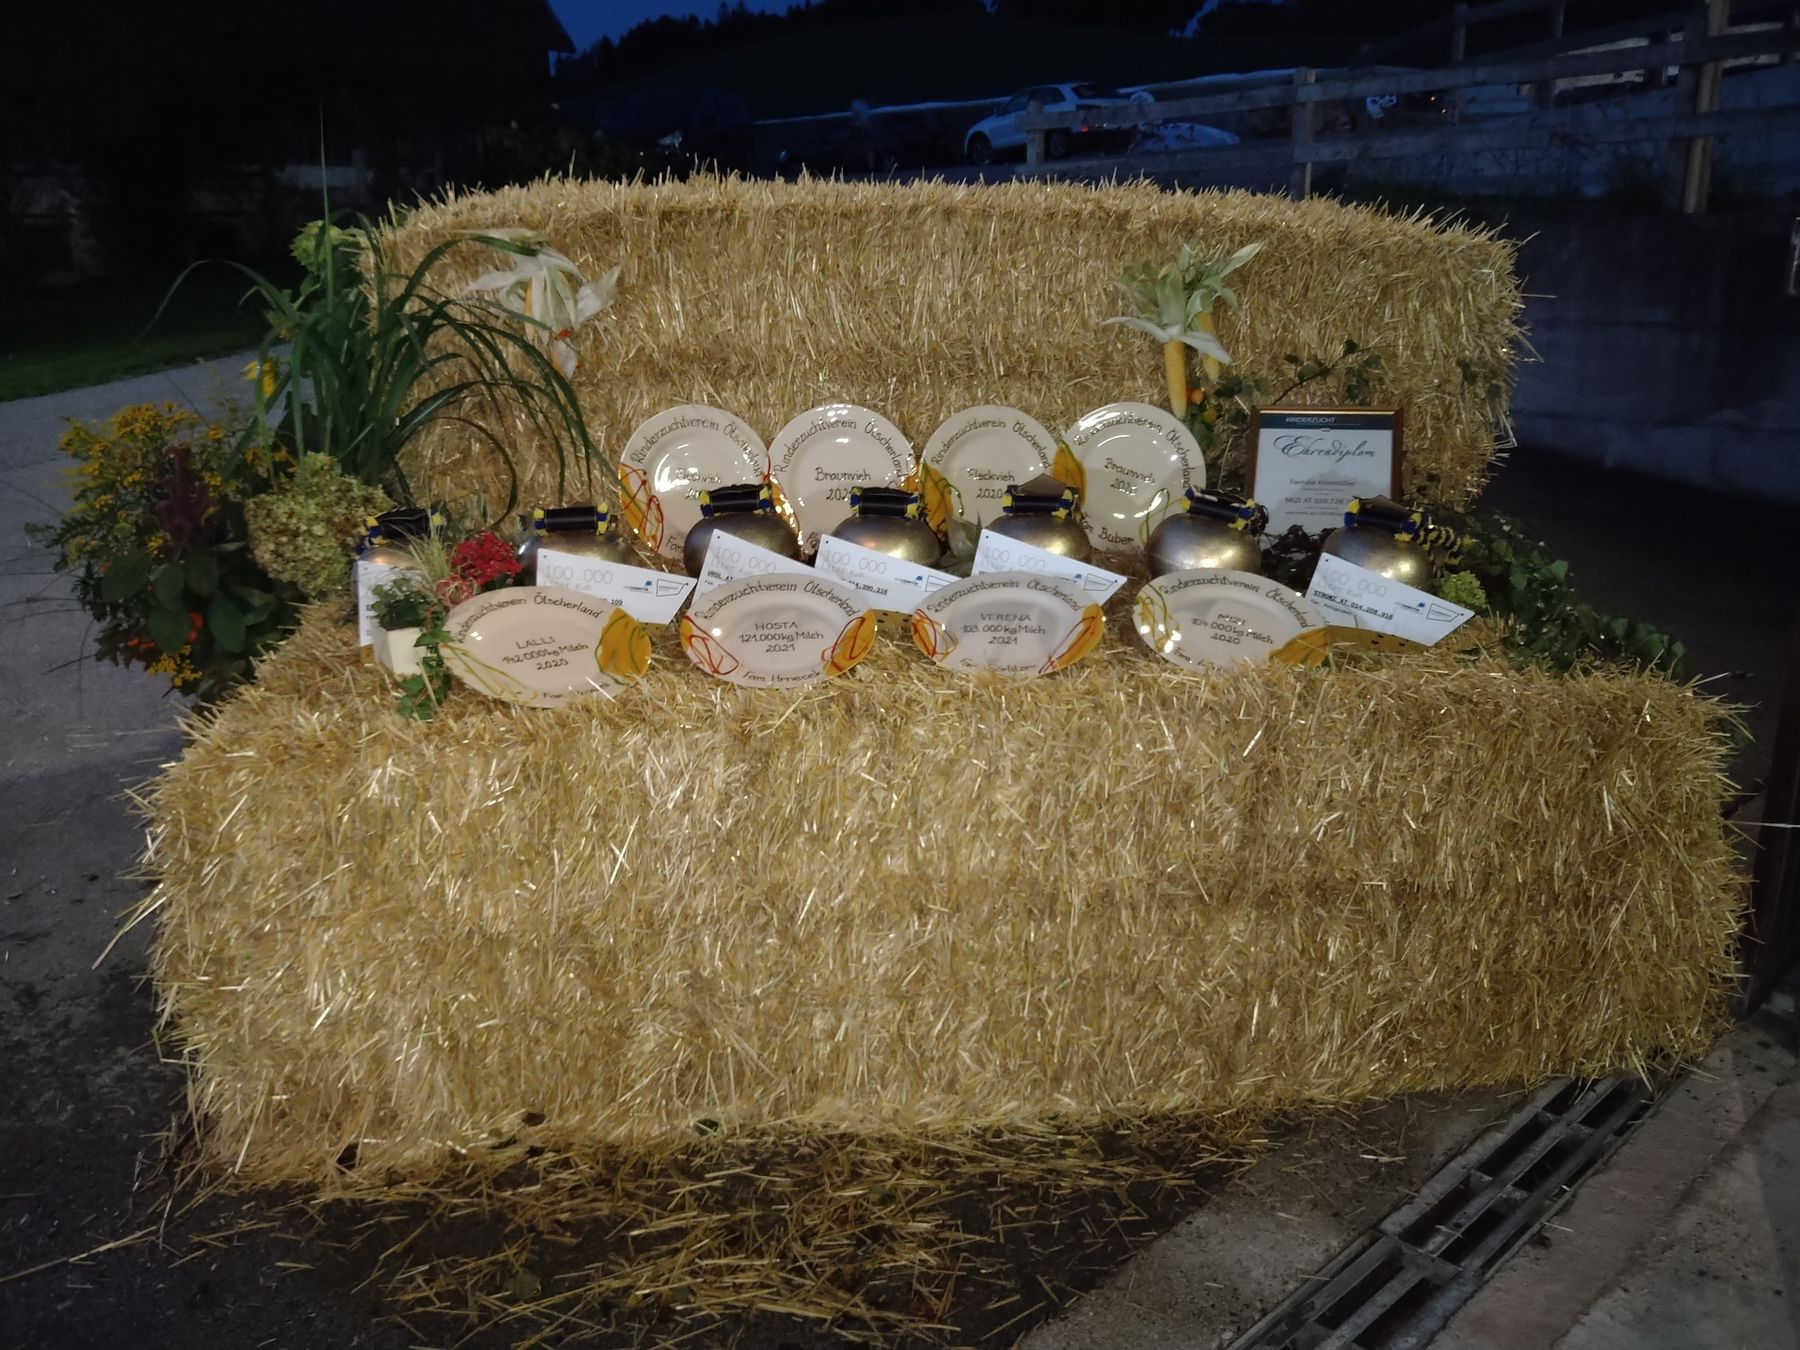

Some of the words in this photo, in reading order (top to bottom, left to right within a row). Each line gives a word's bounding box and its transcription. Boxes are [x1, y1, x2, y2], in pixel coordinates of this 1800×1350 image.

[1273, 434, 1376, 463] Ehrendiplom
[815, 466, 871, 482] Braunvieh
[968, 467, 1015, 482] Fleckvieh
[980, 612, 1032, 622] VERENA
[755, 621, 799, 631] HOSTA
[515, 635, 555, 650] LALLI
[988, 636, 1018, 645] 2021
[1210, 633, 1241, 644] 2020
[765, 643, 796, 653] 2021
